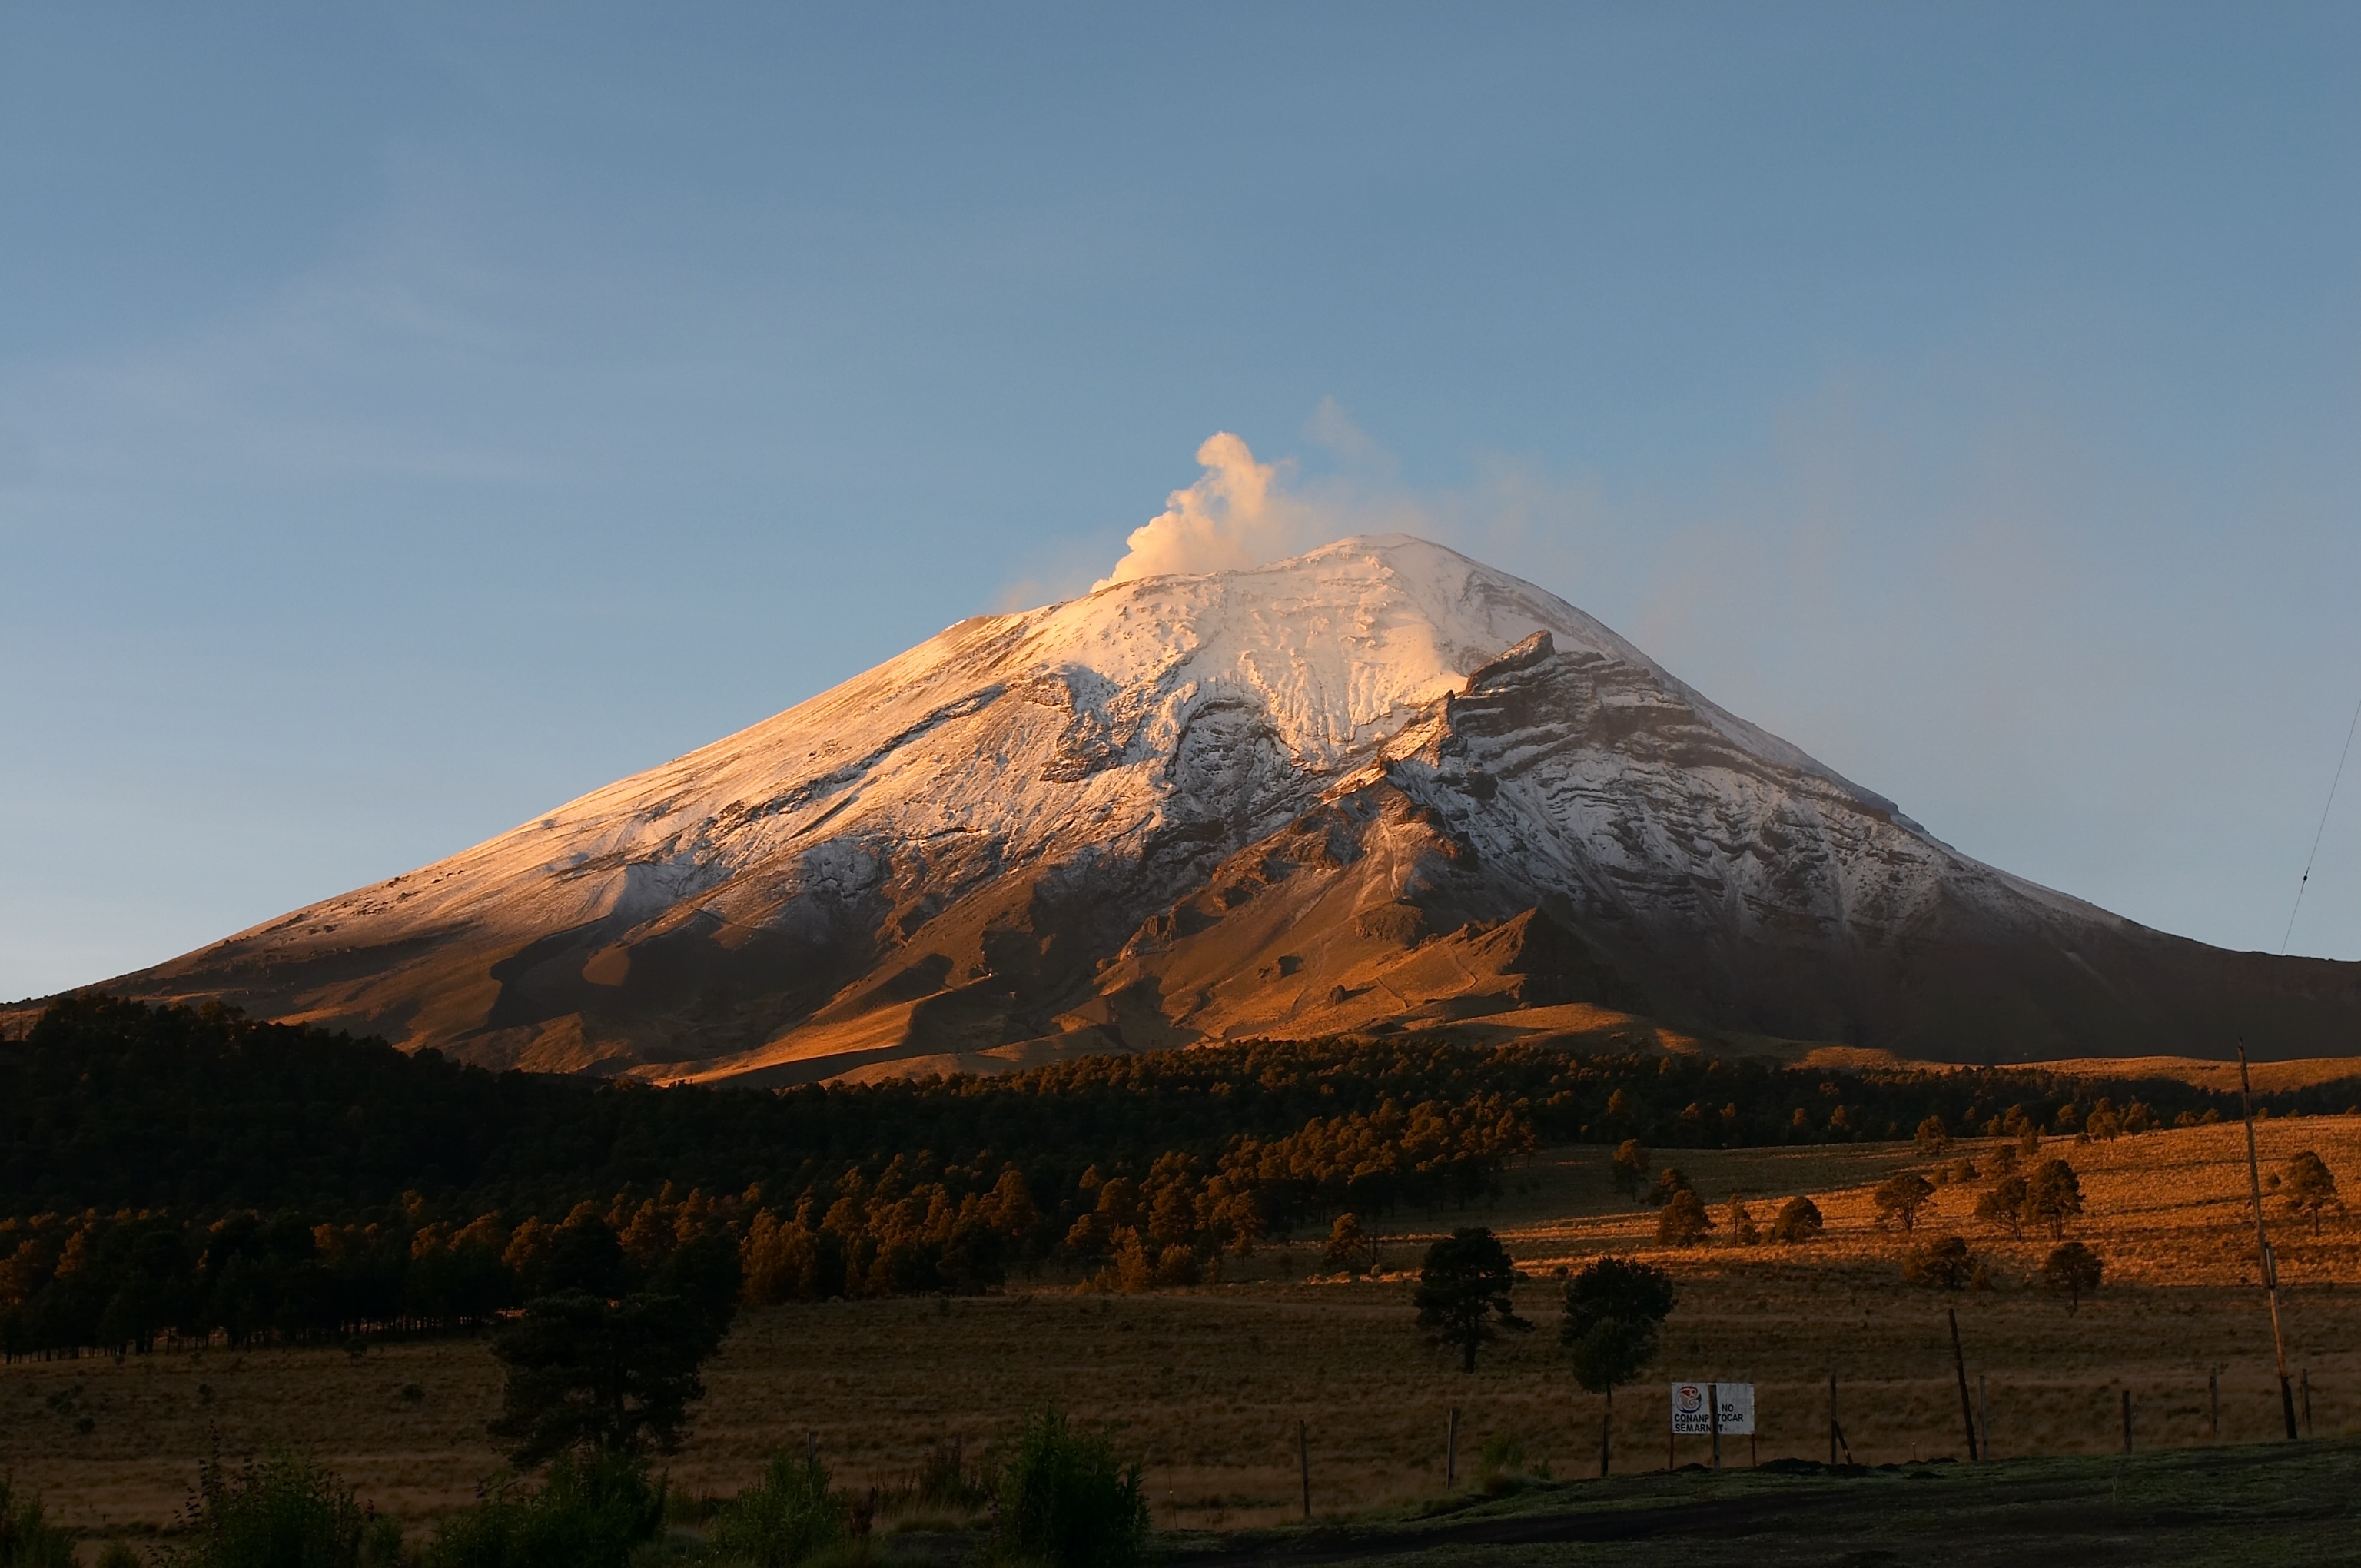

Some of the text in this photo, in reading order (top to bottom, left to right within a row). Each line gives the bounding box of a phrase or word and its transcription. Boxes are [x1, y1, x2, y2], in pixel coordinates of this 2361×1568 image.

[1722, 1404, 1734, 1412] NO
[1674, 1414, 1709, 1422] CONANP
[1675, 1423, 1723, 1432] SEMARNT
